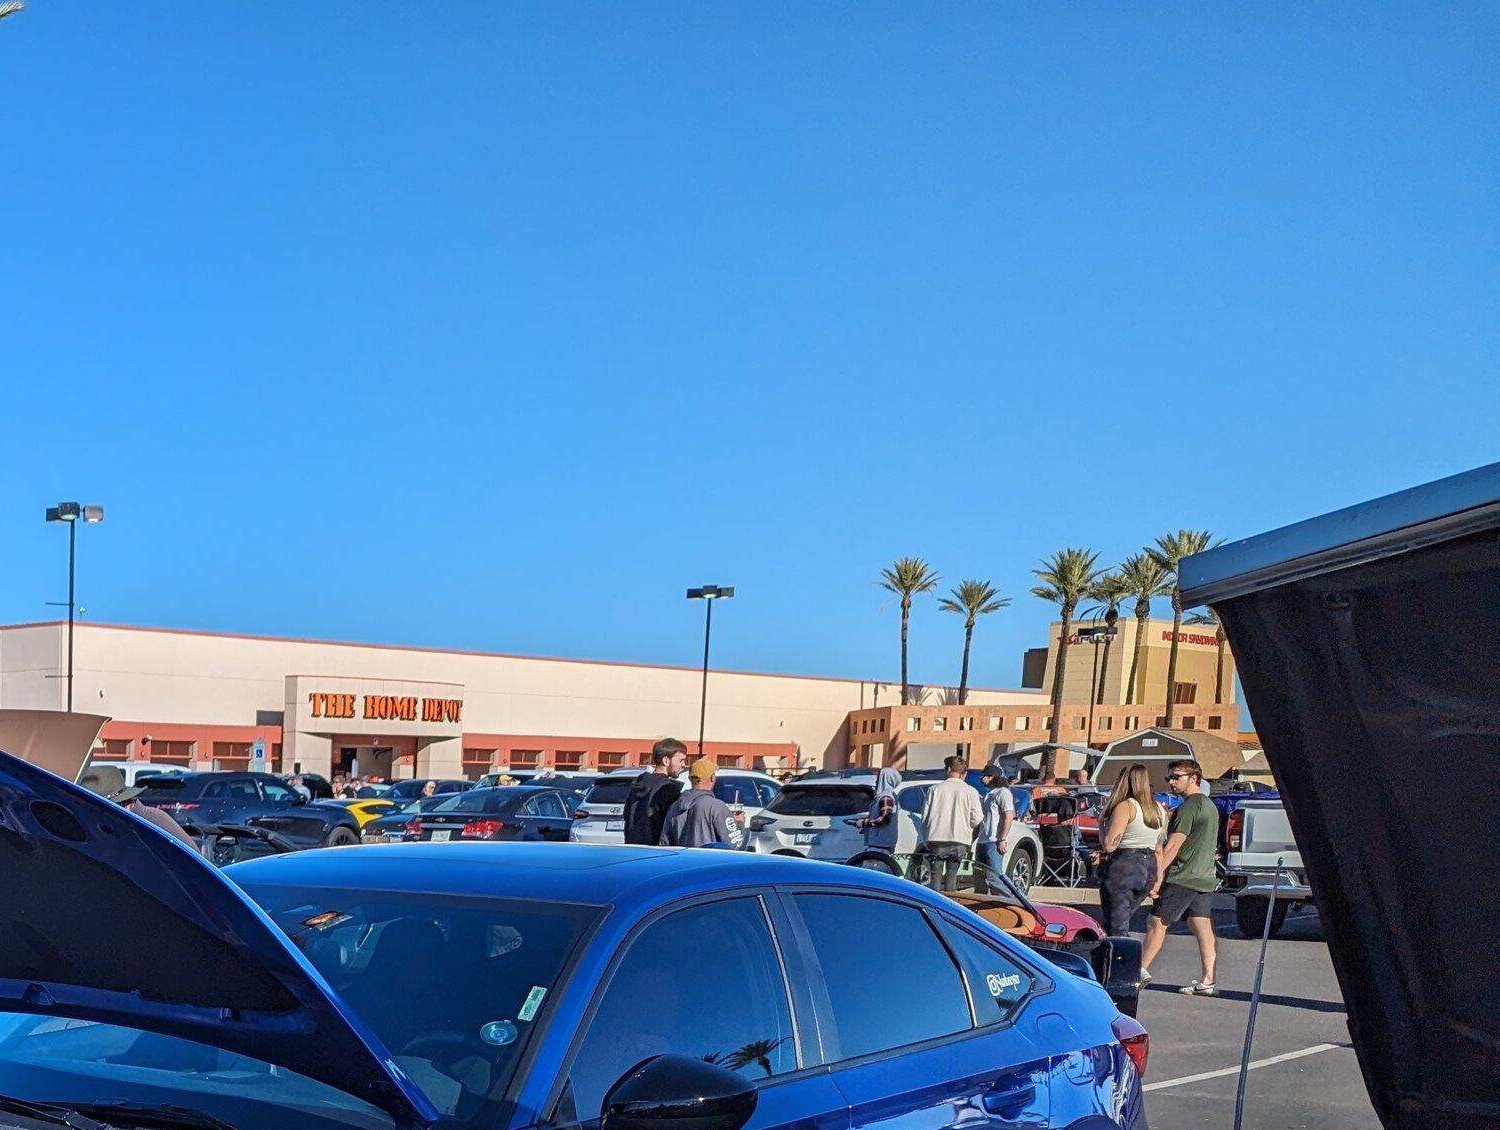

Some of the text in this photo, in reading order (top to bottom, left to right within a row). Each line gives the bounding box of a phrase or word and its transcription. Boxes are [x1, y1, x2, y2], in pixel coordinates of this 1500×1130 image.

[309, 692, 463, 724] THE HOME DEPOT
